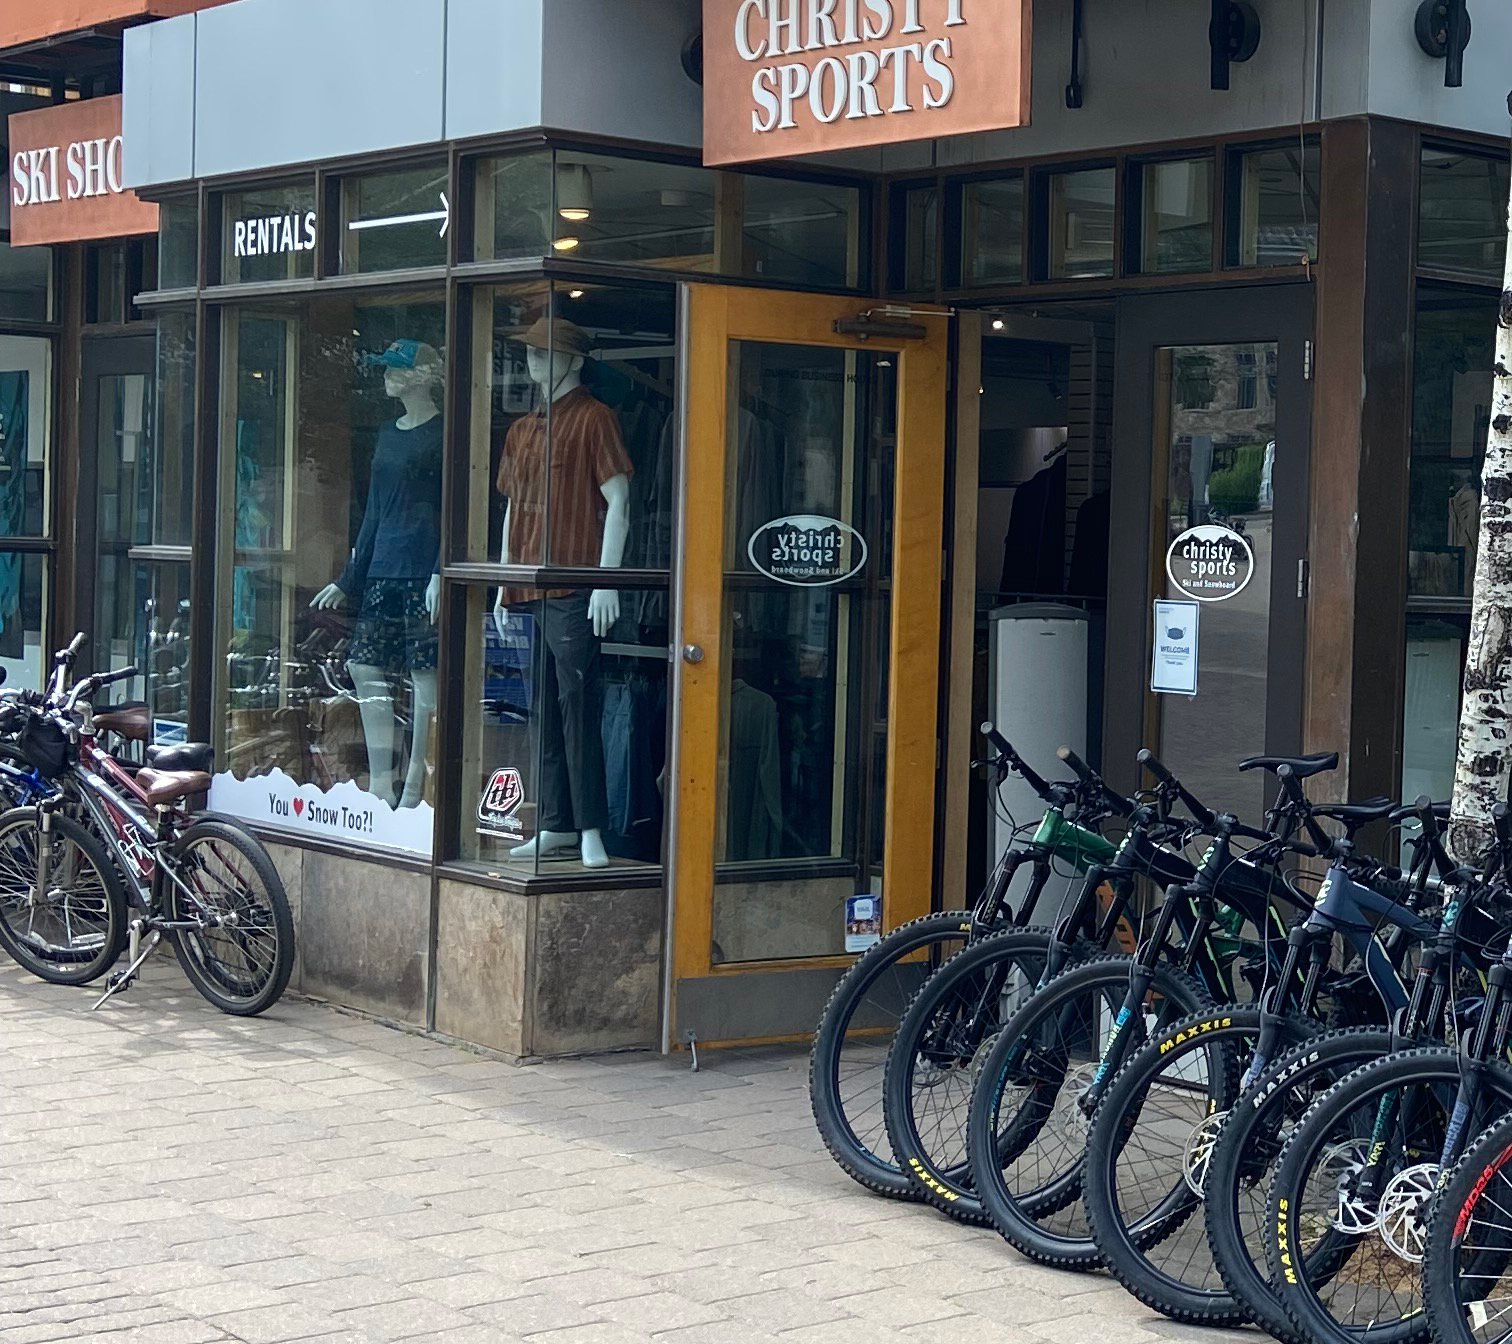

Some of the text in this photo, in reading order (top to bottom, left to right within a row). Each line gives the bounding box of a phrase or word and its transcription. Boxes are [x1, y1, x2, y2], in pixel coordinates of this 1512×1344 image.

[751, 38, 955, 134] SPORTS
[13, 135, 123, 207] SKI SHO
[234, 212, 316, 257] RENTALS
[1182, 541, 1233, 563] christy
[1190, 559, 1236, 579] sports
[268, 792, 374, 833] You Snow Too?!
[1160, 1017, 1232, 1054] MAXXIS
[1252, 1051, 1319, 1109] MAXXIS
[908, 1158, 960, 1201] MAXXIS
[1277, 1198, 1298, 1284] MAXXIS
